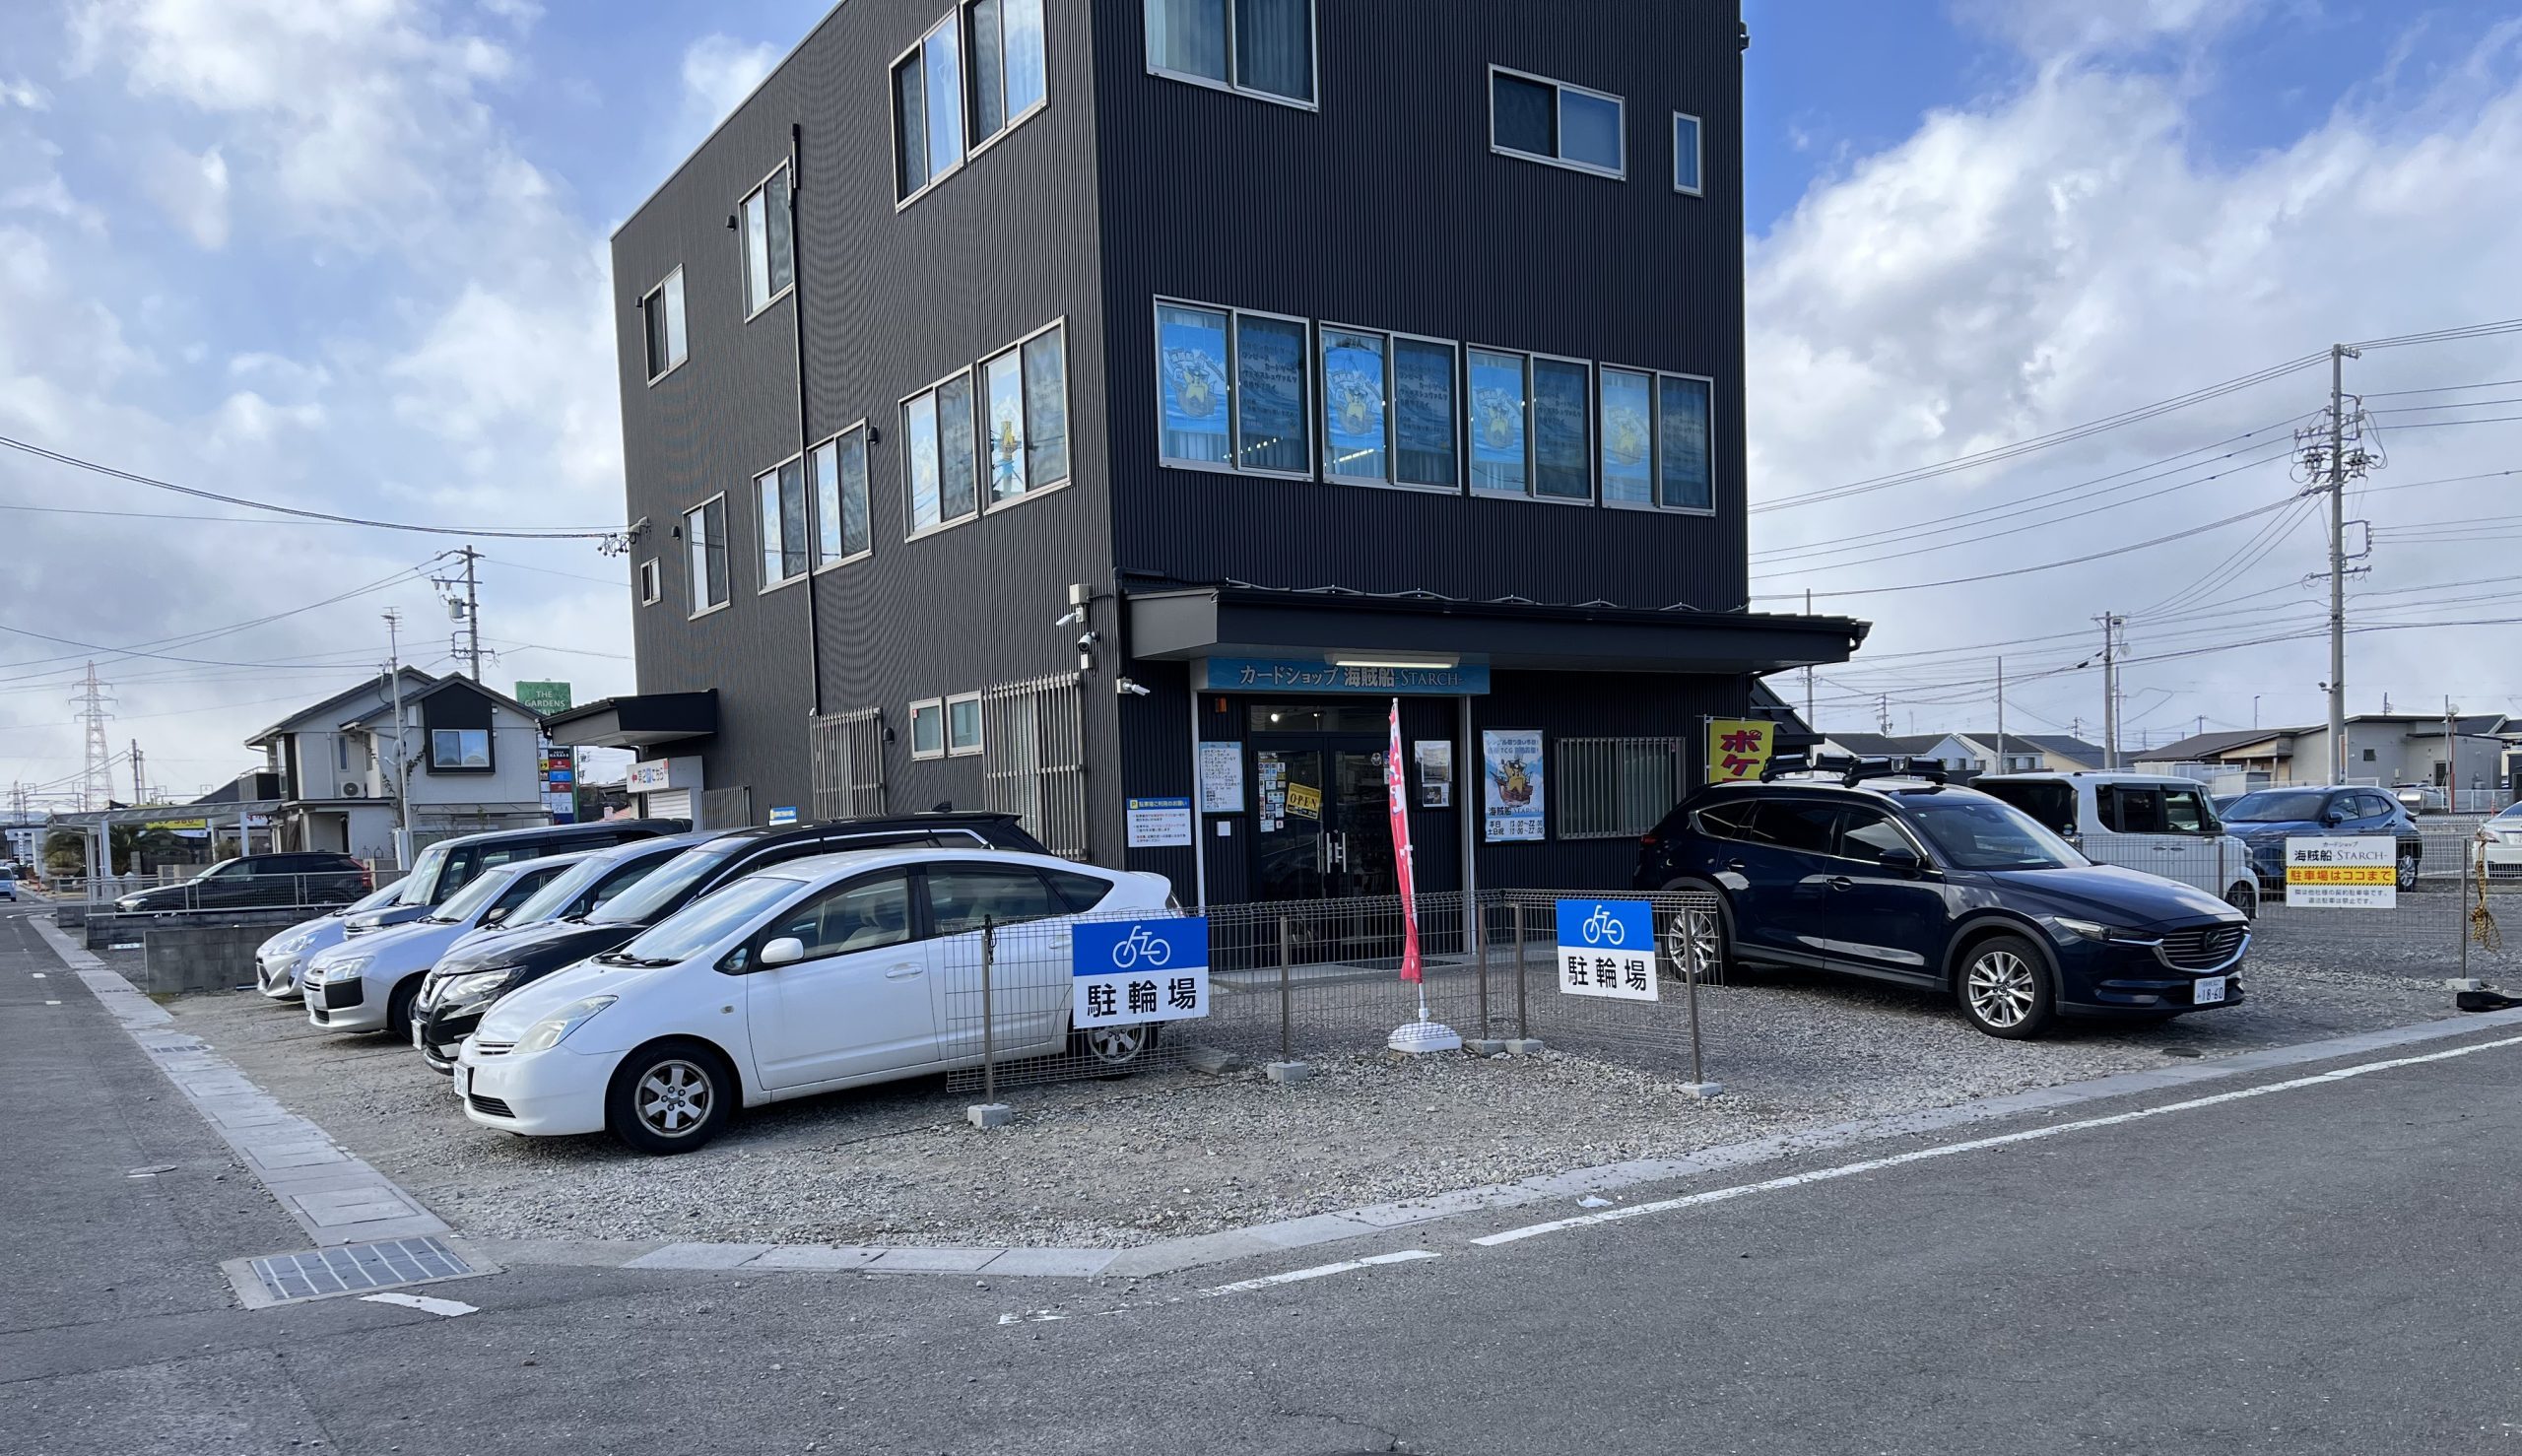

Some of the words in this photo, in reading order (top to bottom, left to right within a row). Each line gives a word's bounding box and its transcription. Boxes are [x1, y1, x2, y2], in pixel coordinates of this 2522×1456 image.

[1239, 664, 1338, 686] カードショップ
[2290, 870, 2392, 882] 駐車場はココまで
[1567, 956, 1647, 992] 駐輪場
[1087, 977, 1197, 1018] 駐輪場
